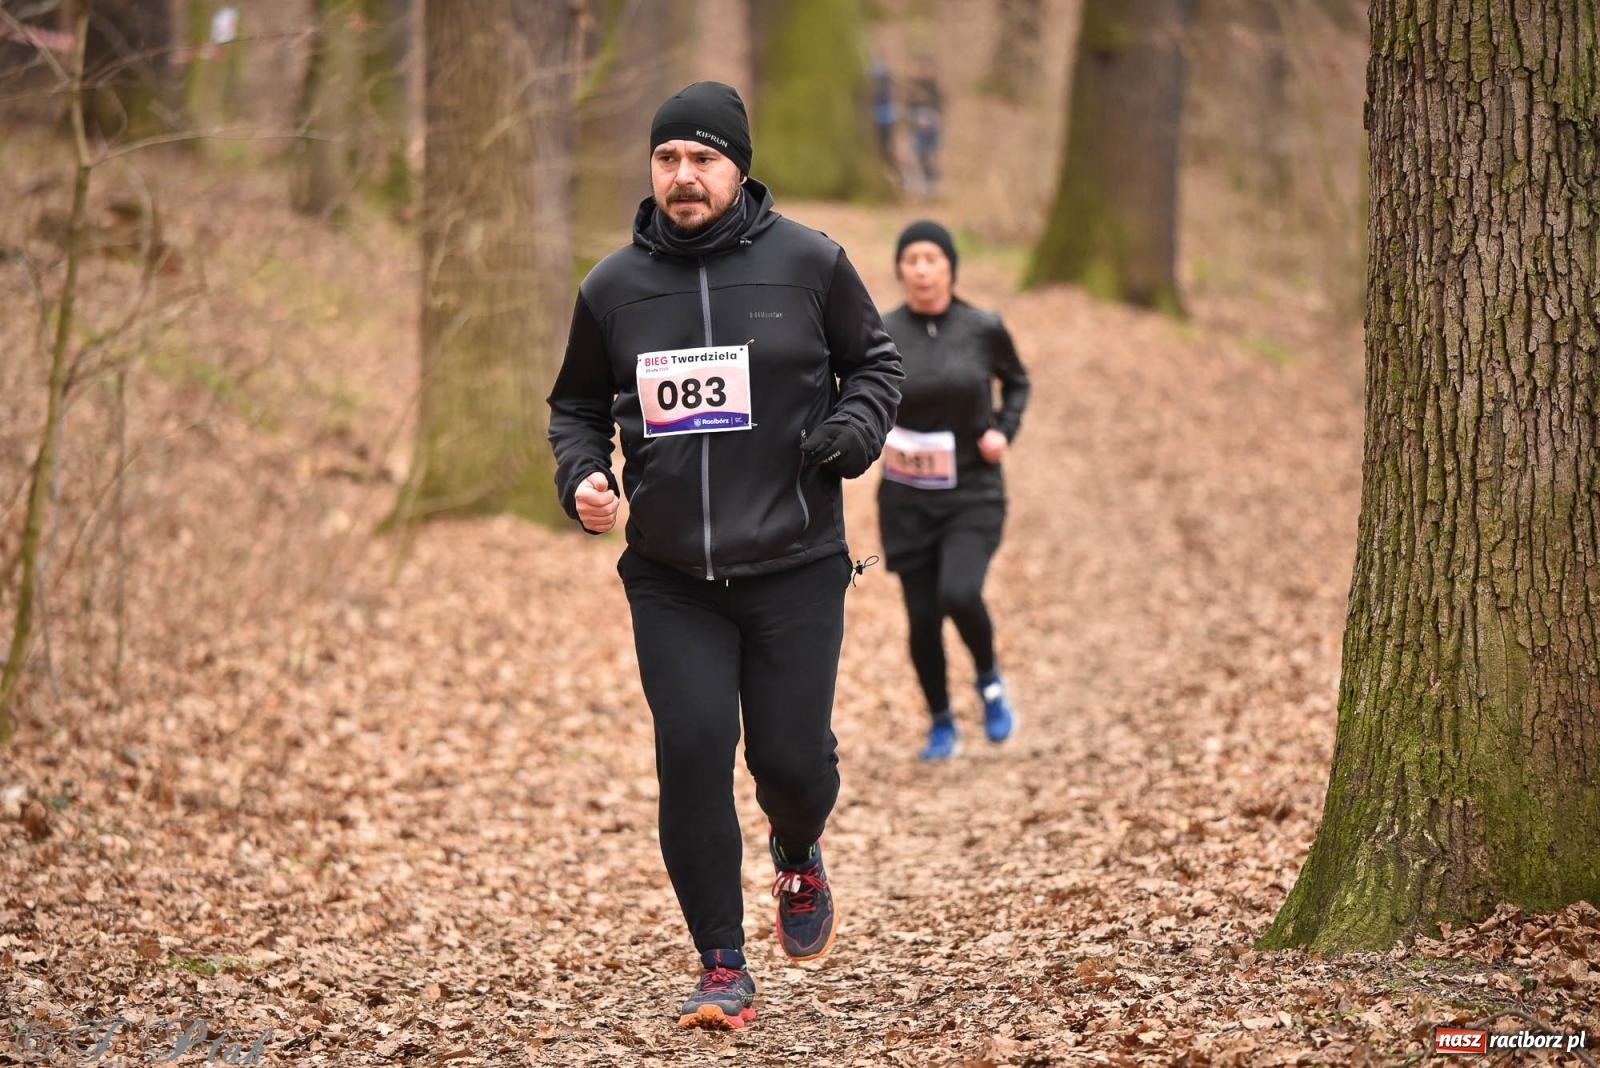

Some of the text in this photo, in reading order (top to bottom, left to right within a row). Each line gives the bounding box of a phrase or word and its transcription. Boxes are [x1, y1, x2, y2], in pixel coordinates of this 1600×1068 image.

[696, 128, 728, 148] KIPRUN
[645, 351, 737, 367] BIEG Twardziela
[657, 376, 727, 411] 083
